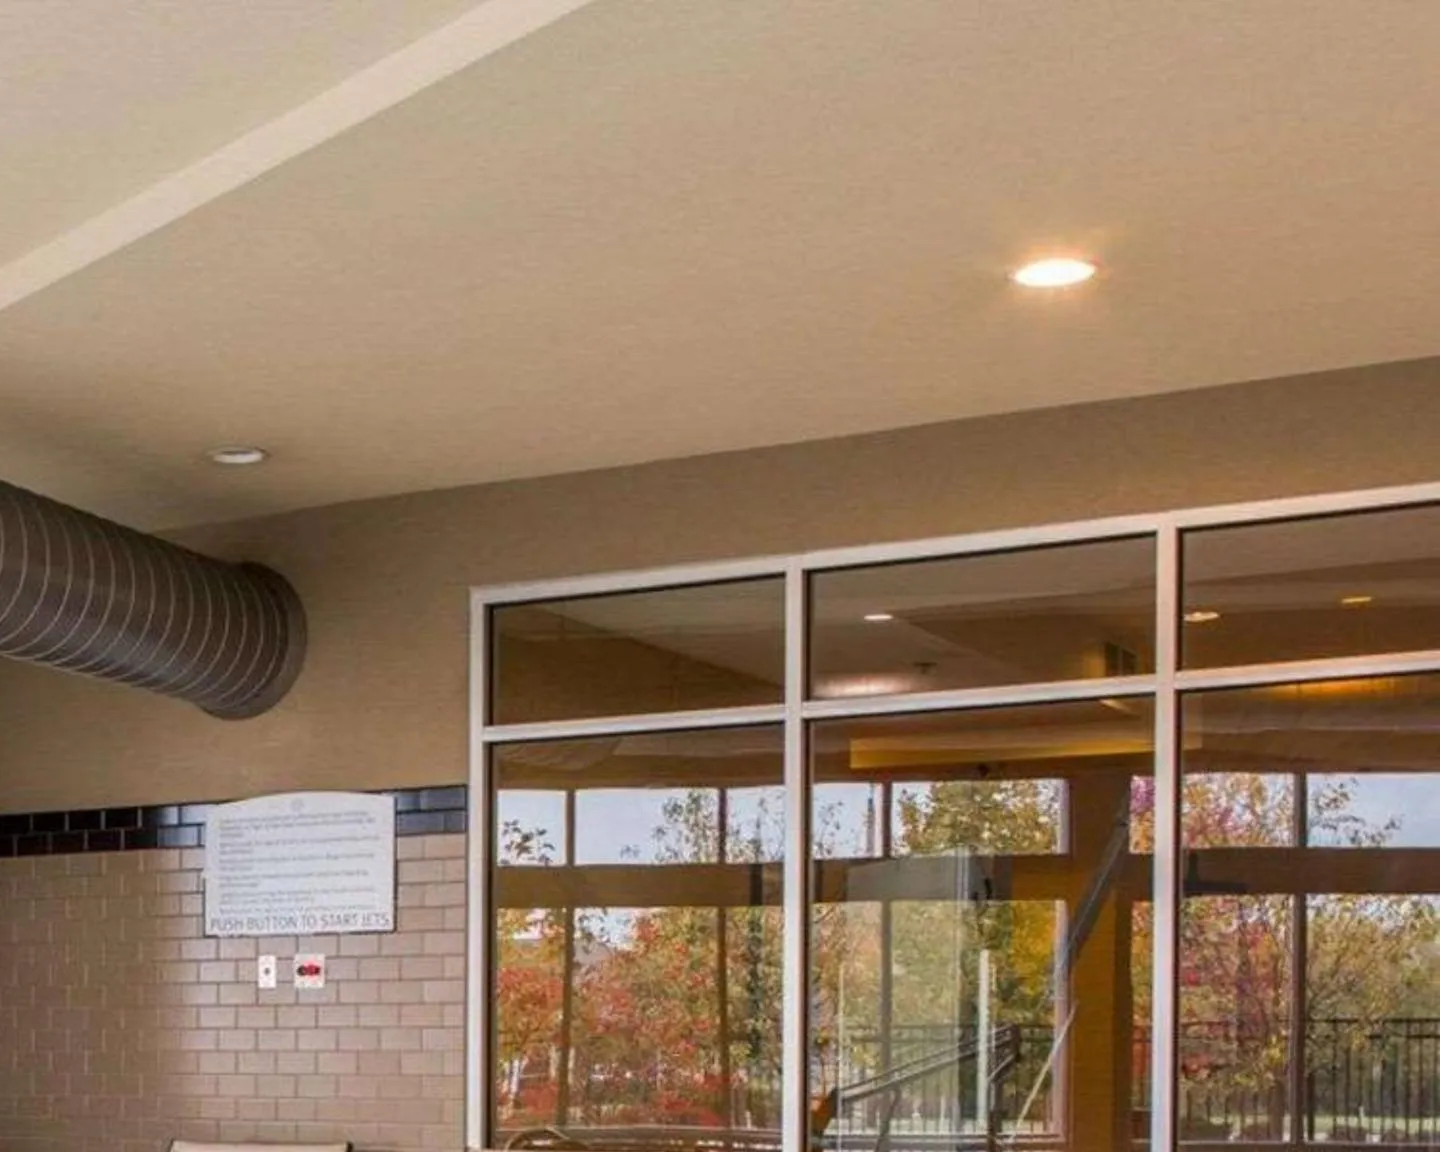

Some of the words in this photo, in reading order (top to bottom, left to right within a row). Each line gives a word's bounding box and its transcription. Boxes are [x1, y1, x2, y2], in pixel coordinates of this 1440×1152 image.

[210, 917, 244, 931] PUSH
[247, 915, 298, 931] BUTTON
[301, 914, 317, 930] TO
[320, 913, 358, 929] START
